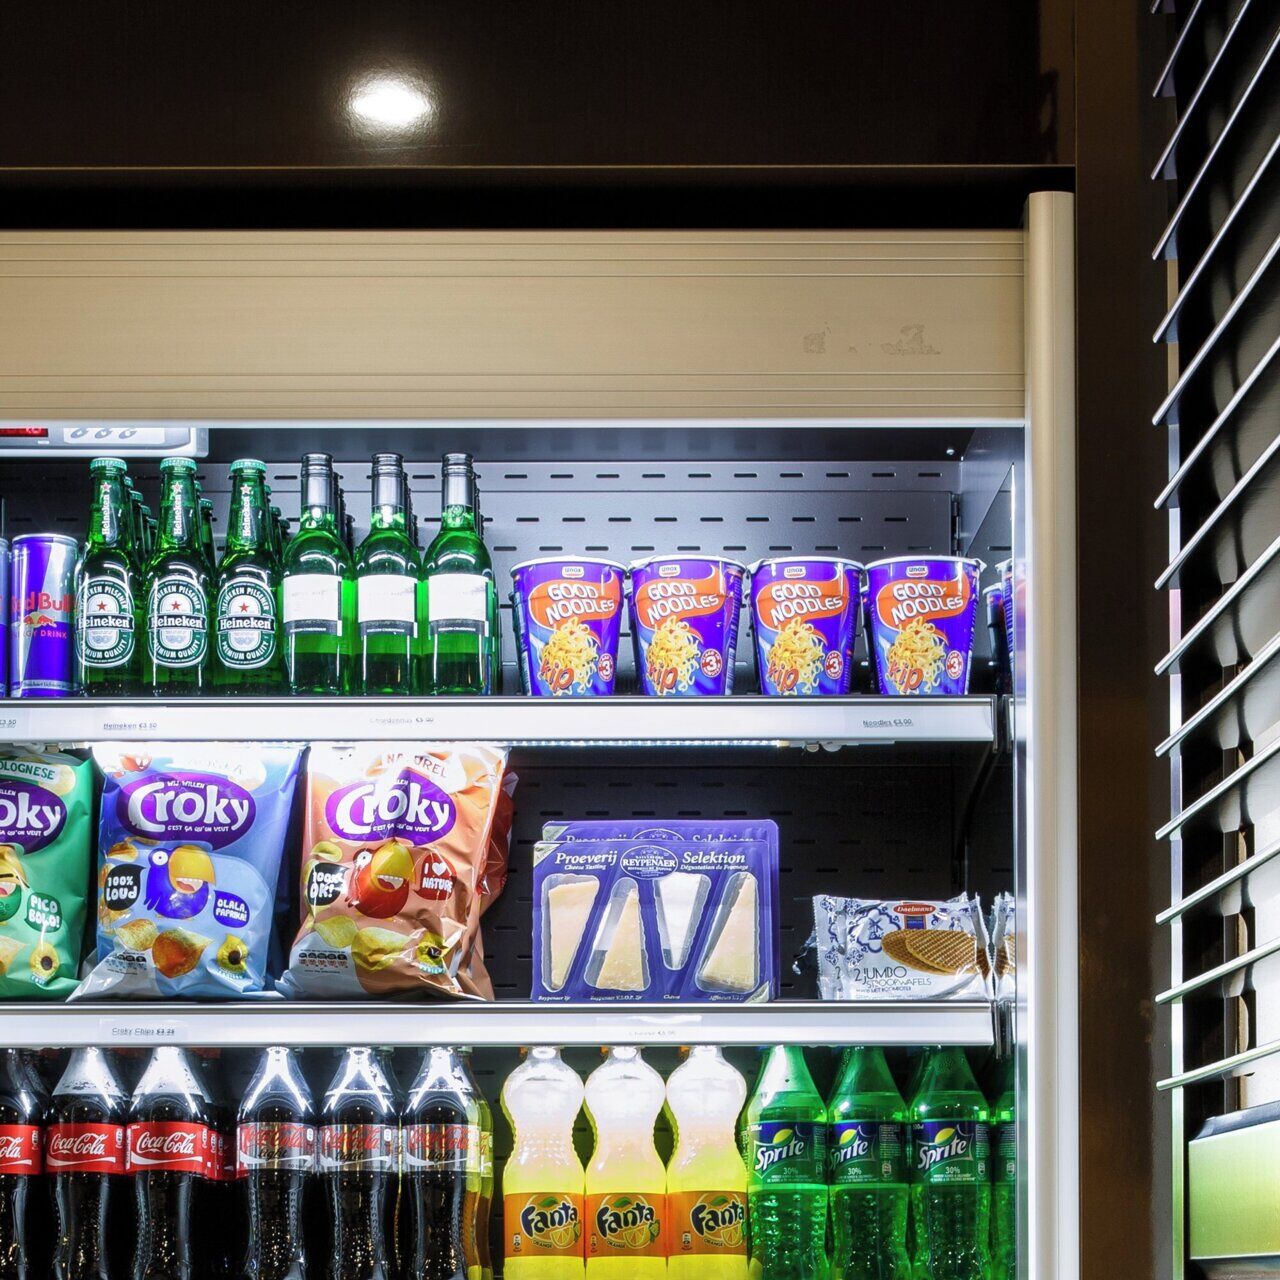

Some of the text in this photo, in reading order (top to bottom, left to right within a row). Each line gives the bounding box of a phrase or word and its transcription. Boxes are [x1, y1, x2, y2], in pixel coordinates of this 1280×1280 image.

[101, 494, 110, 536] Heineken
[173, 494, 182, 536] Heineken
[242, 496, 251, 537] Heineken
[246, 586, 270, 611] PILSENER
[547, 583, 599, 600] GOOD
[647, 582, 697, 601] GOOD
[771, 583, 823, 601] GOOD
[893, 582, 945, 601] GOOD
[545, 599, 615, 625] NOODLES
[646, 594, 719, 626] NOODLES
[771, 597, 843, 626] NOODLES
[891, 597, 964, 626] NOODLES
[78, 615, 130, 629] Heineken
[151, 615, 203, 629] Heineken
[220, 618, 271, 631] Heineken
[40, 630, 67, 640] DRINK
[178, 640, 201, 659] QUALITY
[221, 640, 269, 660] PREMIUM QUALITY
[539, 657, 575, 694] kip
[647, 658, 679, 694] kip
[768, 660, 800, 694] kip
[888, 660, 924, 692] kip
[128, 781, 249, 832] Croky
[336, 782, 450, 834] Croky
[554, 851, 618, 866] Proeverij
[622, 858, 676, 867] REYPENAER
[682, 851, 745, 864] Selektion
[107, 875, 134, 886] 100%
[897, 905, 934, 913] Daelmans
[854, 968, 862, 982] 2
[51, 1133, 109, 1155] Coca-Cola
[136, 1131, 197, 1154] Coca-Cola
[754, 1139, 805, 1172] Sprite
[918, 1138, 967, 1170] Sprite
[847, 1167, 862, 1176] 30%
[945, 1166, 961, 1175] 30%
[520, 1200, 579, 1238] Fanta
[596, 1201, 655, 1239] Fanta
[690, 1201, 745, 1237] Fanta
[532, 1238, 553, 1249] ORANGE
[606, 1239, 627, 1249] ORANGE
[703, 1238, 724, 1248] ORANGE
